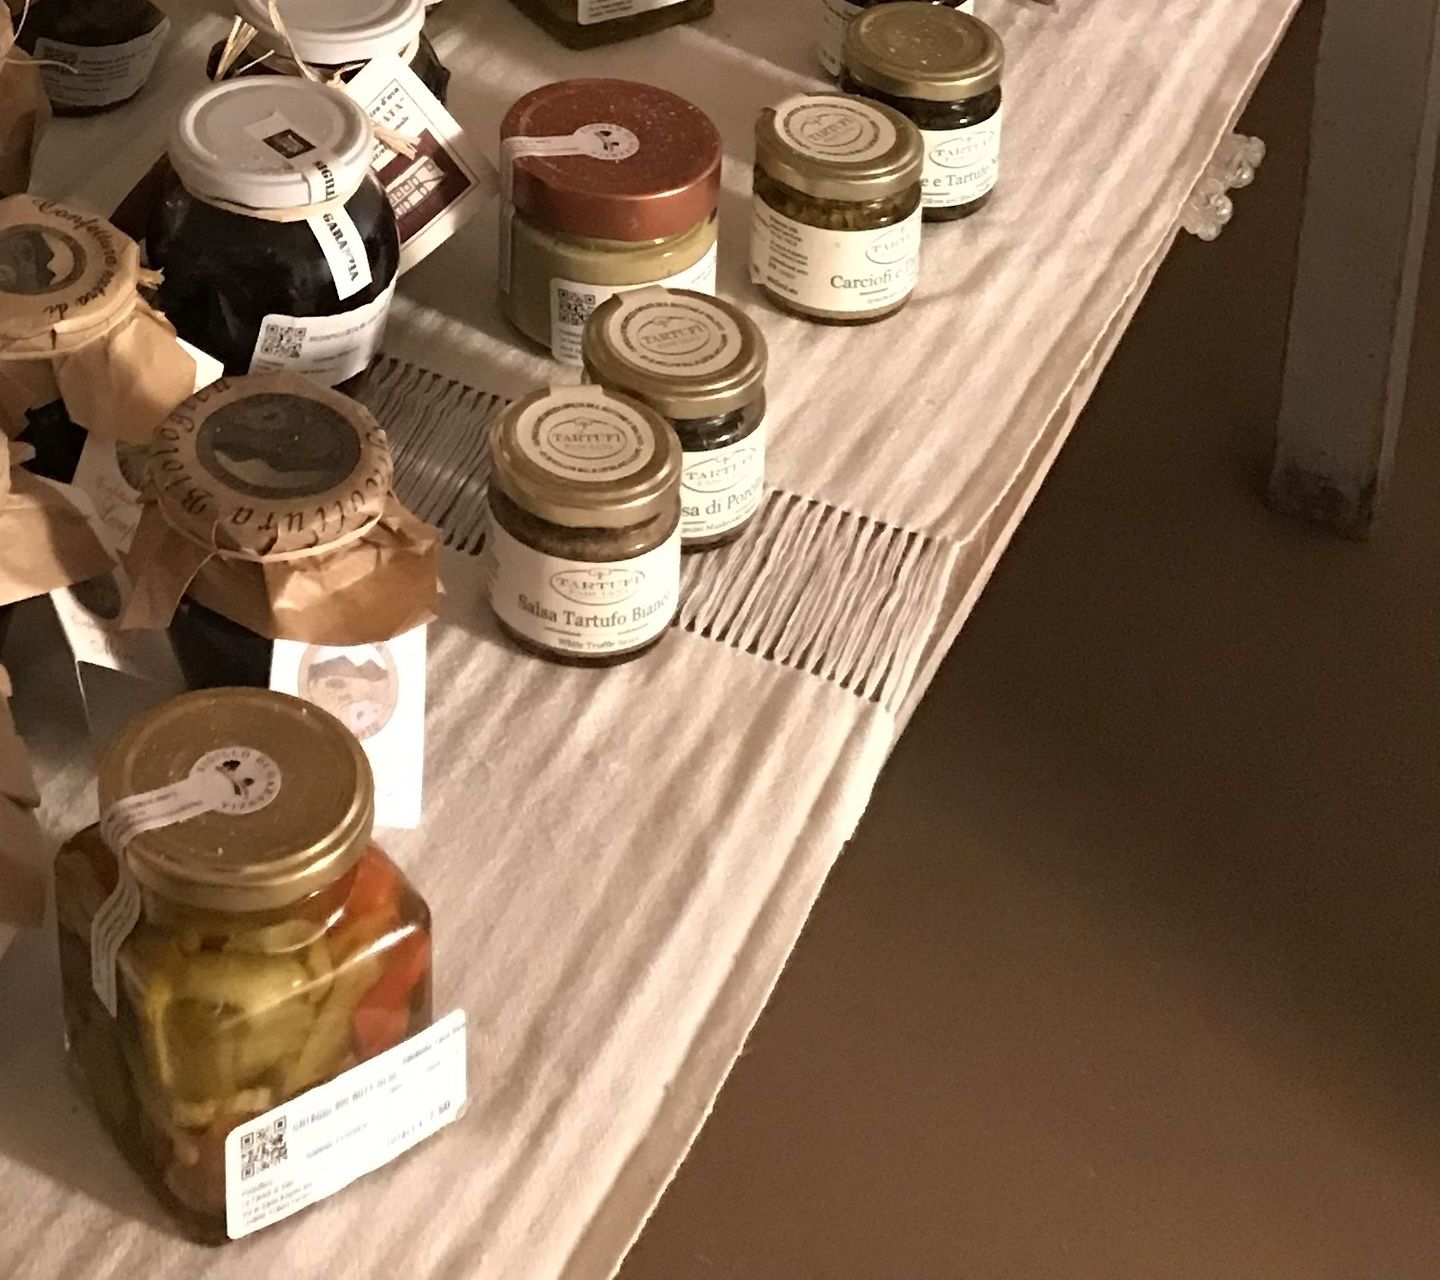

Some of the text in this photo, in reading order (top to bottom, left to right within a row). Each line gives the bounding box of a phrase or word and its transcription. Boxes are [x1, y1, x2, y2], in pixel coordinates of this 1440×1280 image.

[830, 269, 892, 289] Carciofi
[705, 499, 721, 515] di
[560, 577, 640, 590] TARTUFI
[519, 594, 558, 623] Salsa
[563, 610, 627, 628] Tartufo
